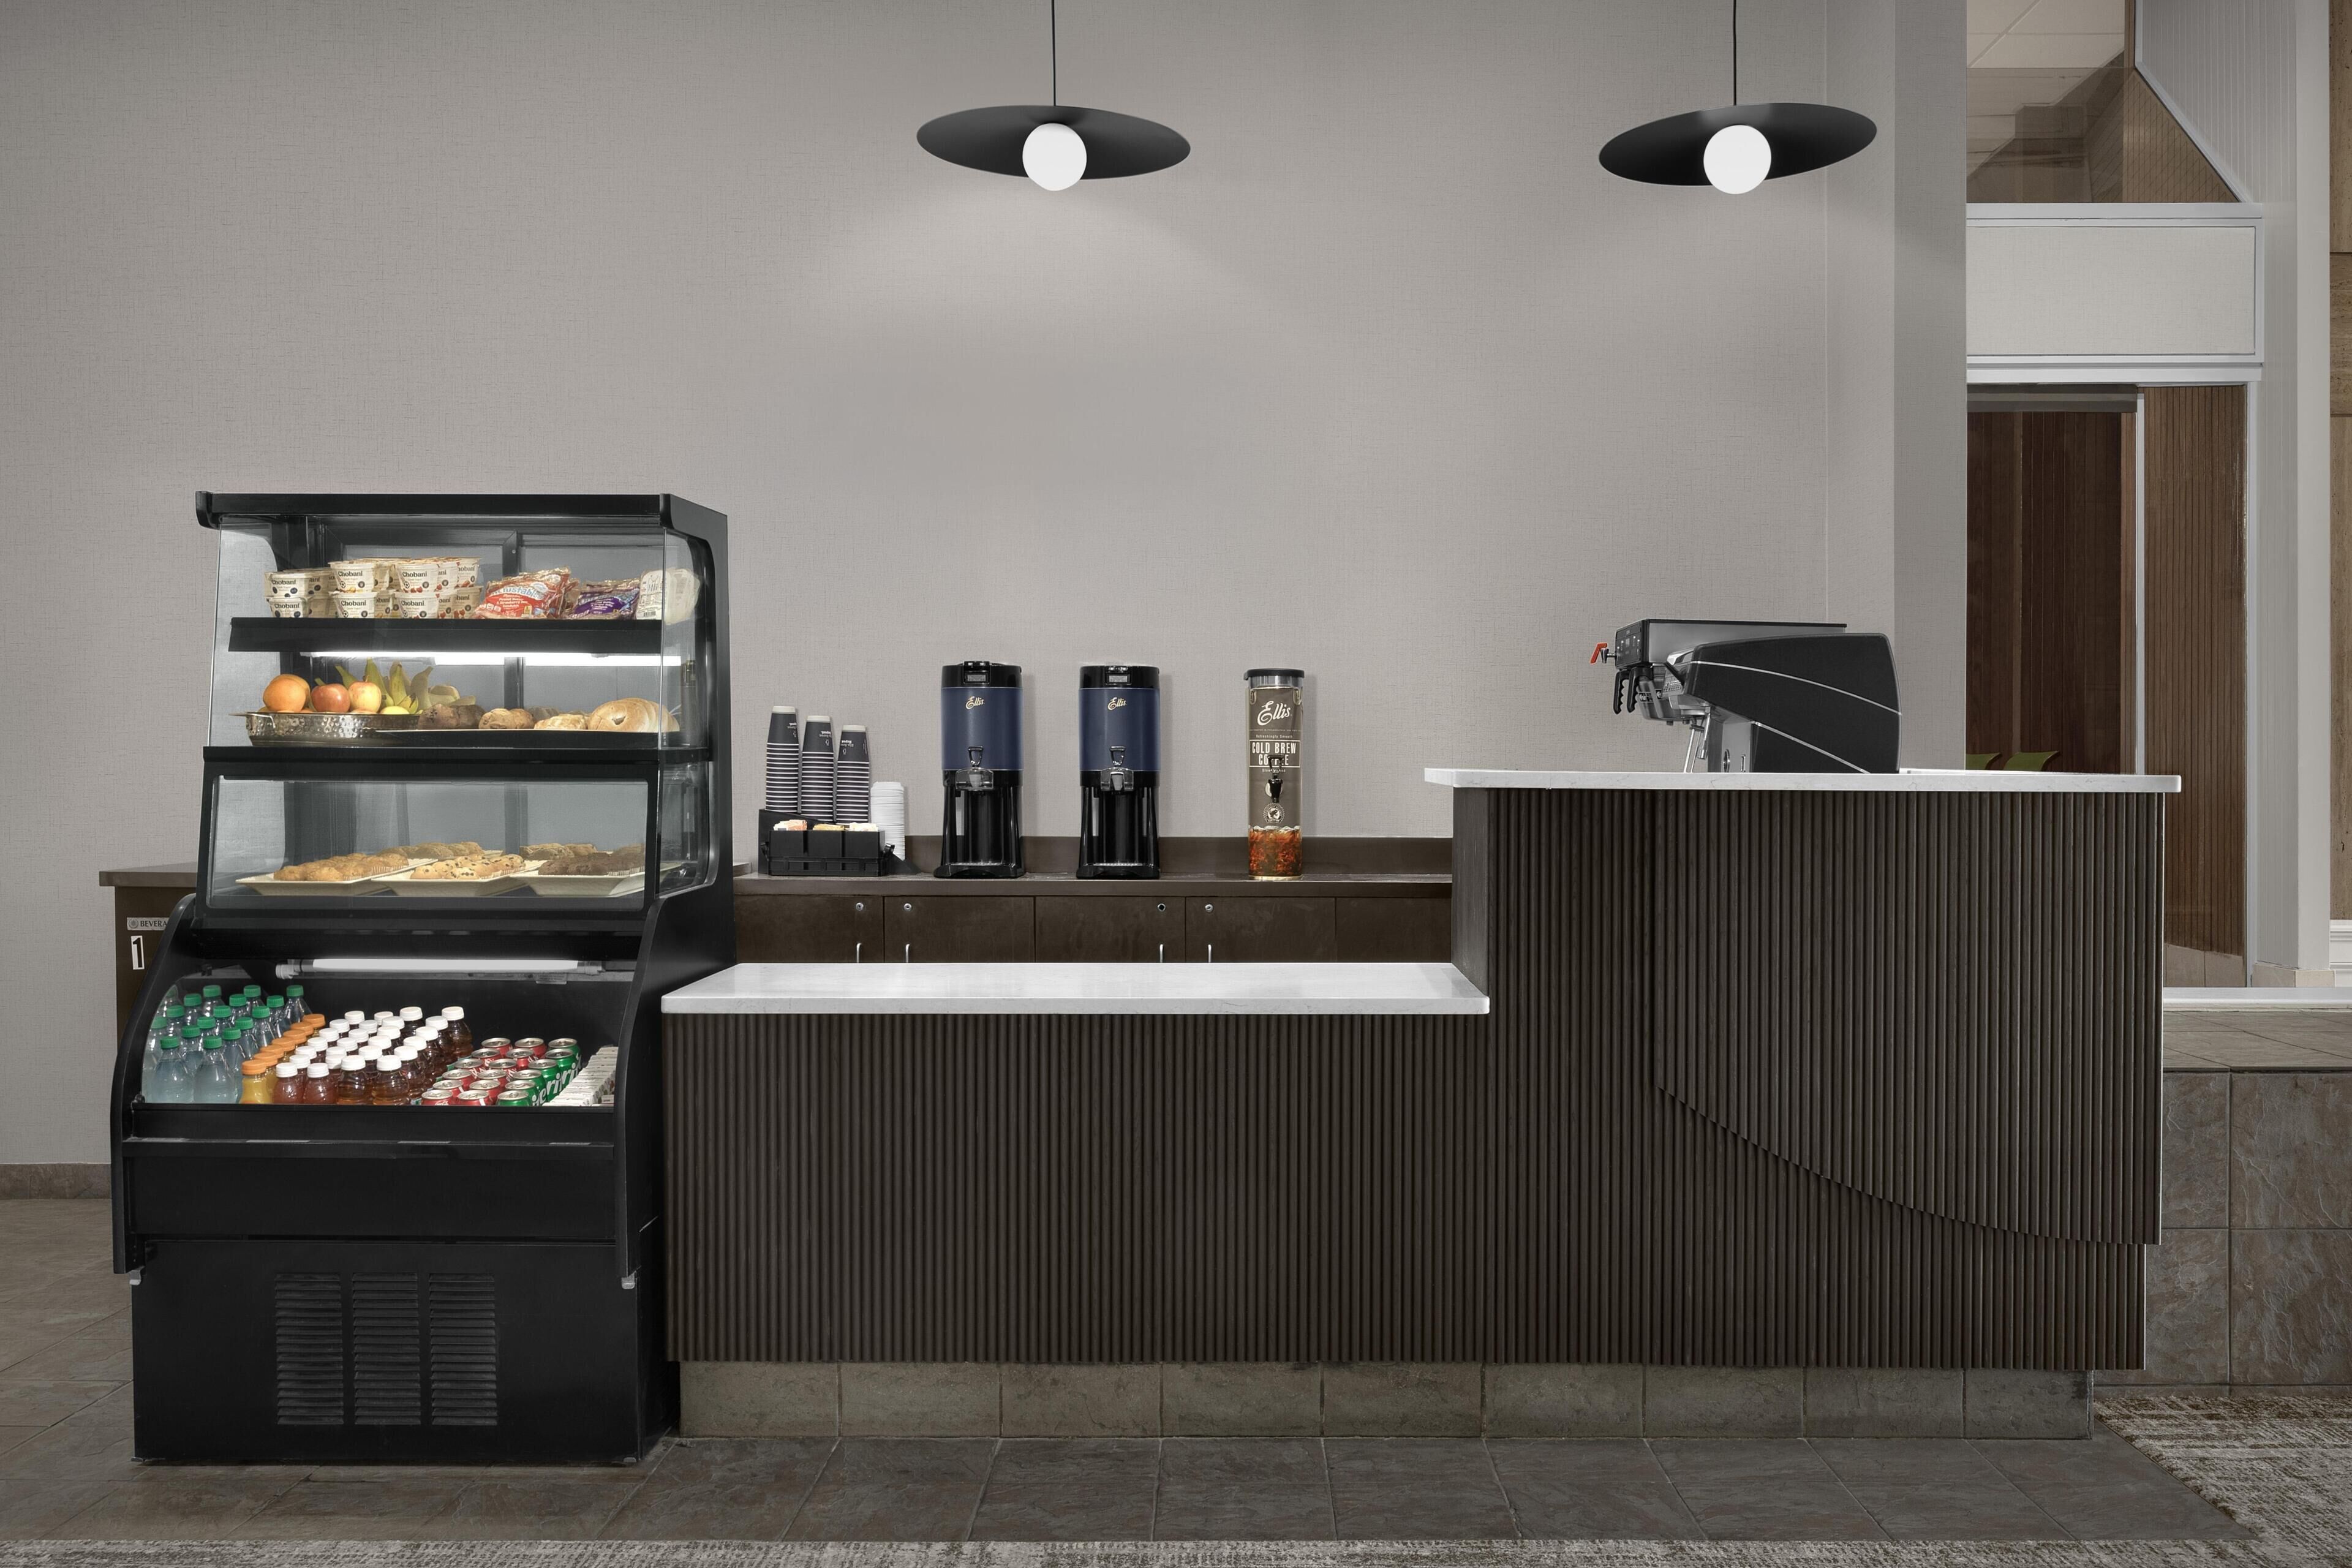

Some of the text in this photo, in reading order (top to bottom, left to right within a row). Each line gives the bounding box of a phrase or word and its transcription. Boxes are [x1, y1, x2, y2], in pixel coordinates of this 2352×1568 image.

[965, 696, 984, 710] Ellis
[1107, 696, 1126, 710] Ellis
[1257, 700, 1291, 726] Ellis
[1252, 742, 1296, 754] COLD BREW
[132, 937, 143, 968] 1
